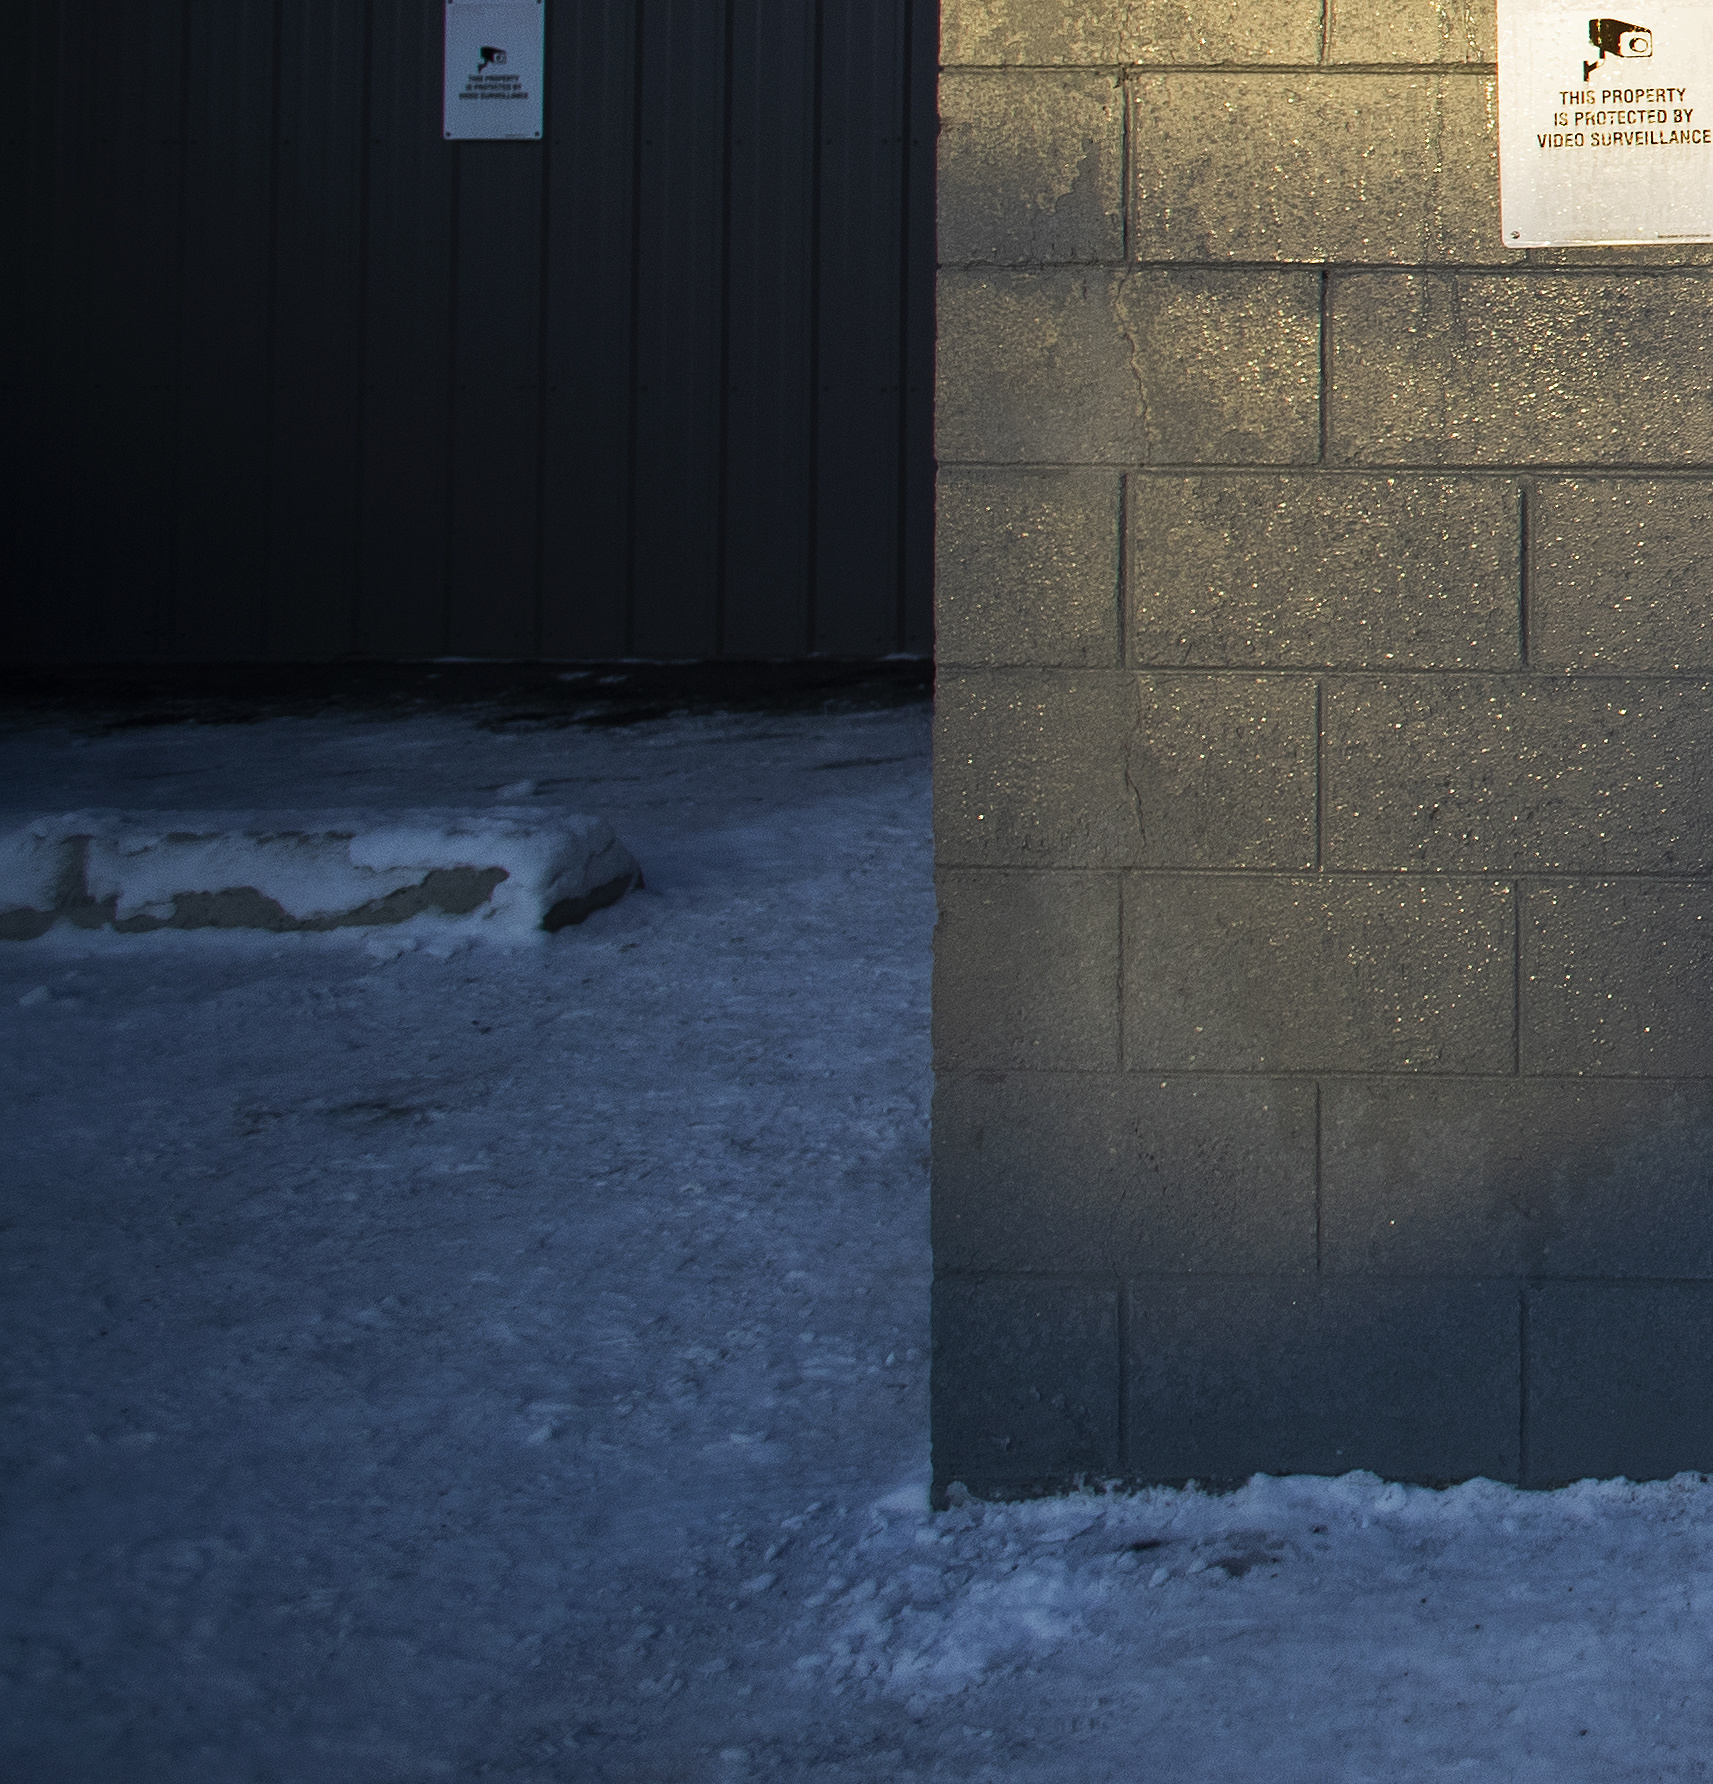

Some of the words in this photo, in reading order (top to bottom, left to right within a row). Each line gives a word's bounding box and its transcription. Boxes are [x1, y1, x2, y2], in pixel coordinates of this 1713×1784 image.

[1560, 90, 1596, 105] THIS
[1602, 88, 1686, 104] PROPERTY
[1554, 112, 1568, 127] IS
[1575, 109, 1667, 126] PROTECTED
[1673, 108, 1694, 123] BY
[1537, 133, 1585, 148] VIDEO
[1591, 129, 1712, 147] SURVEILLANCE
